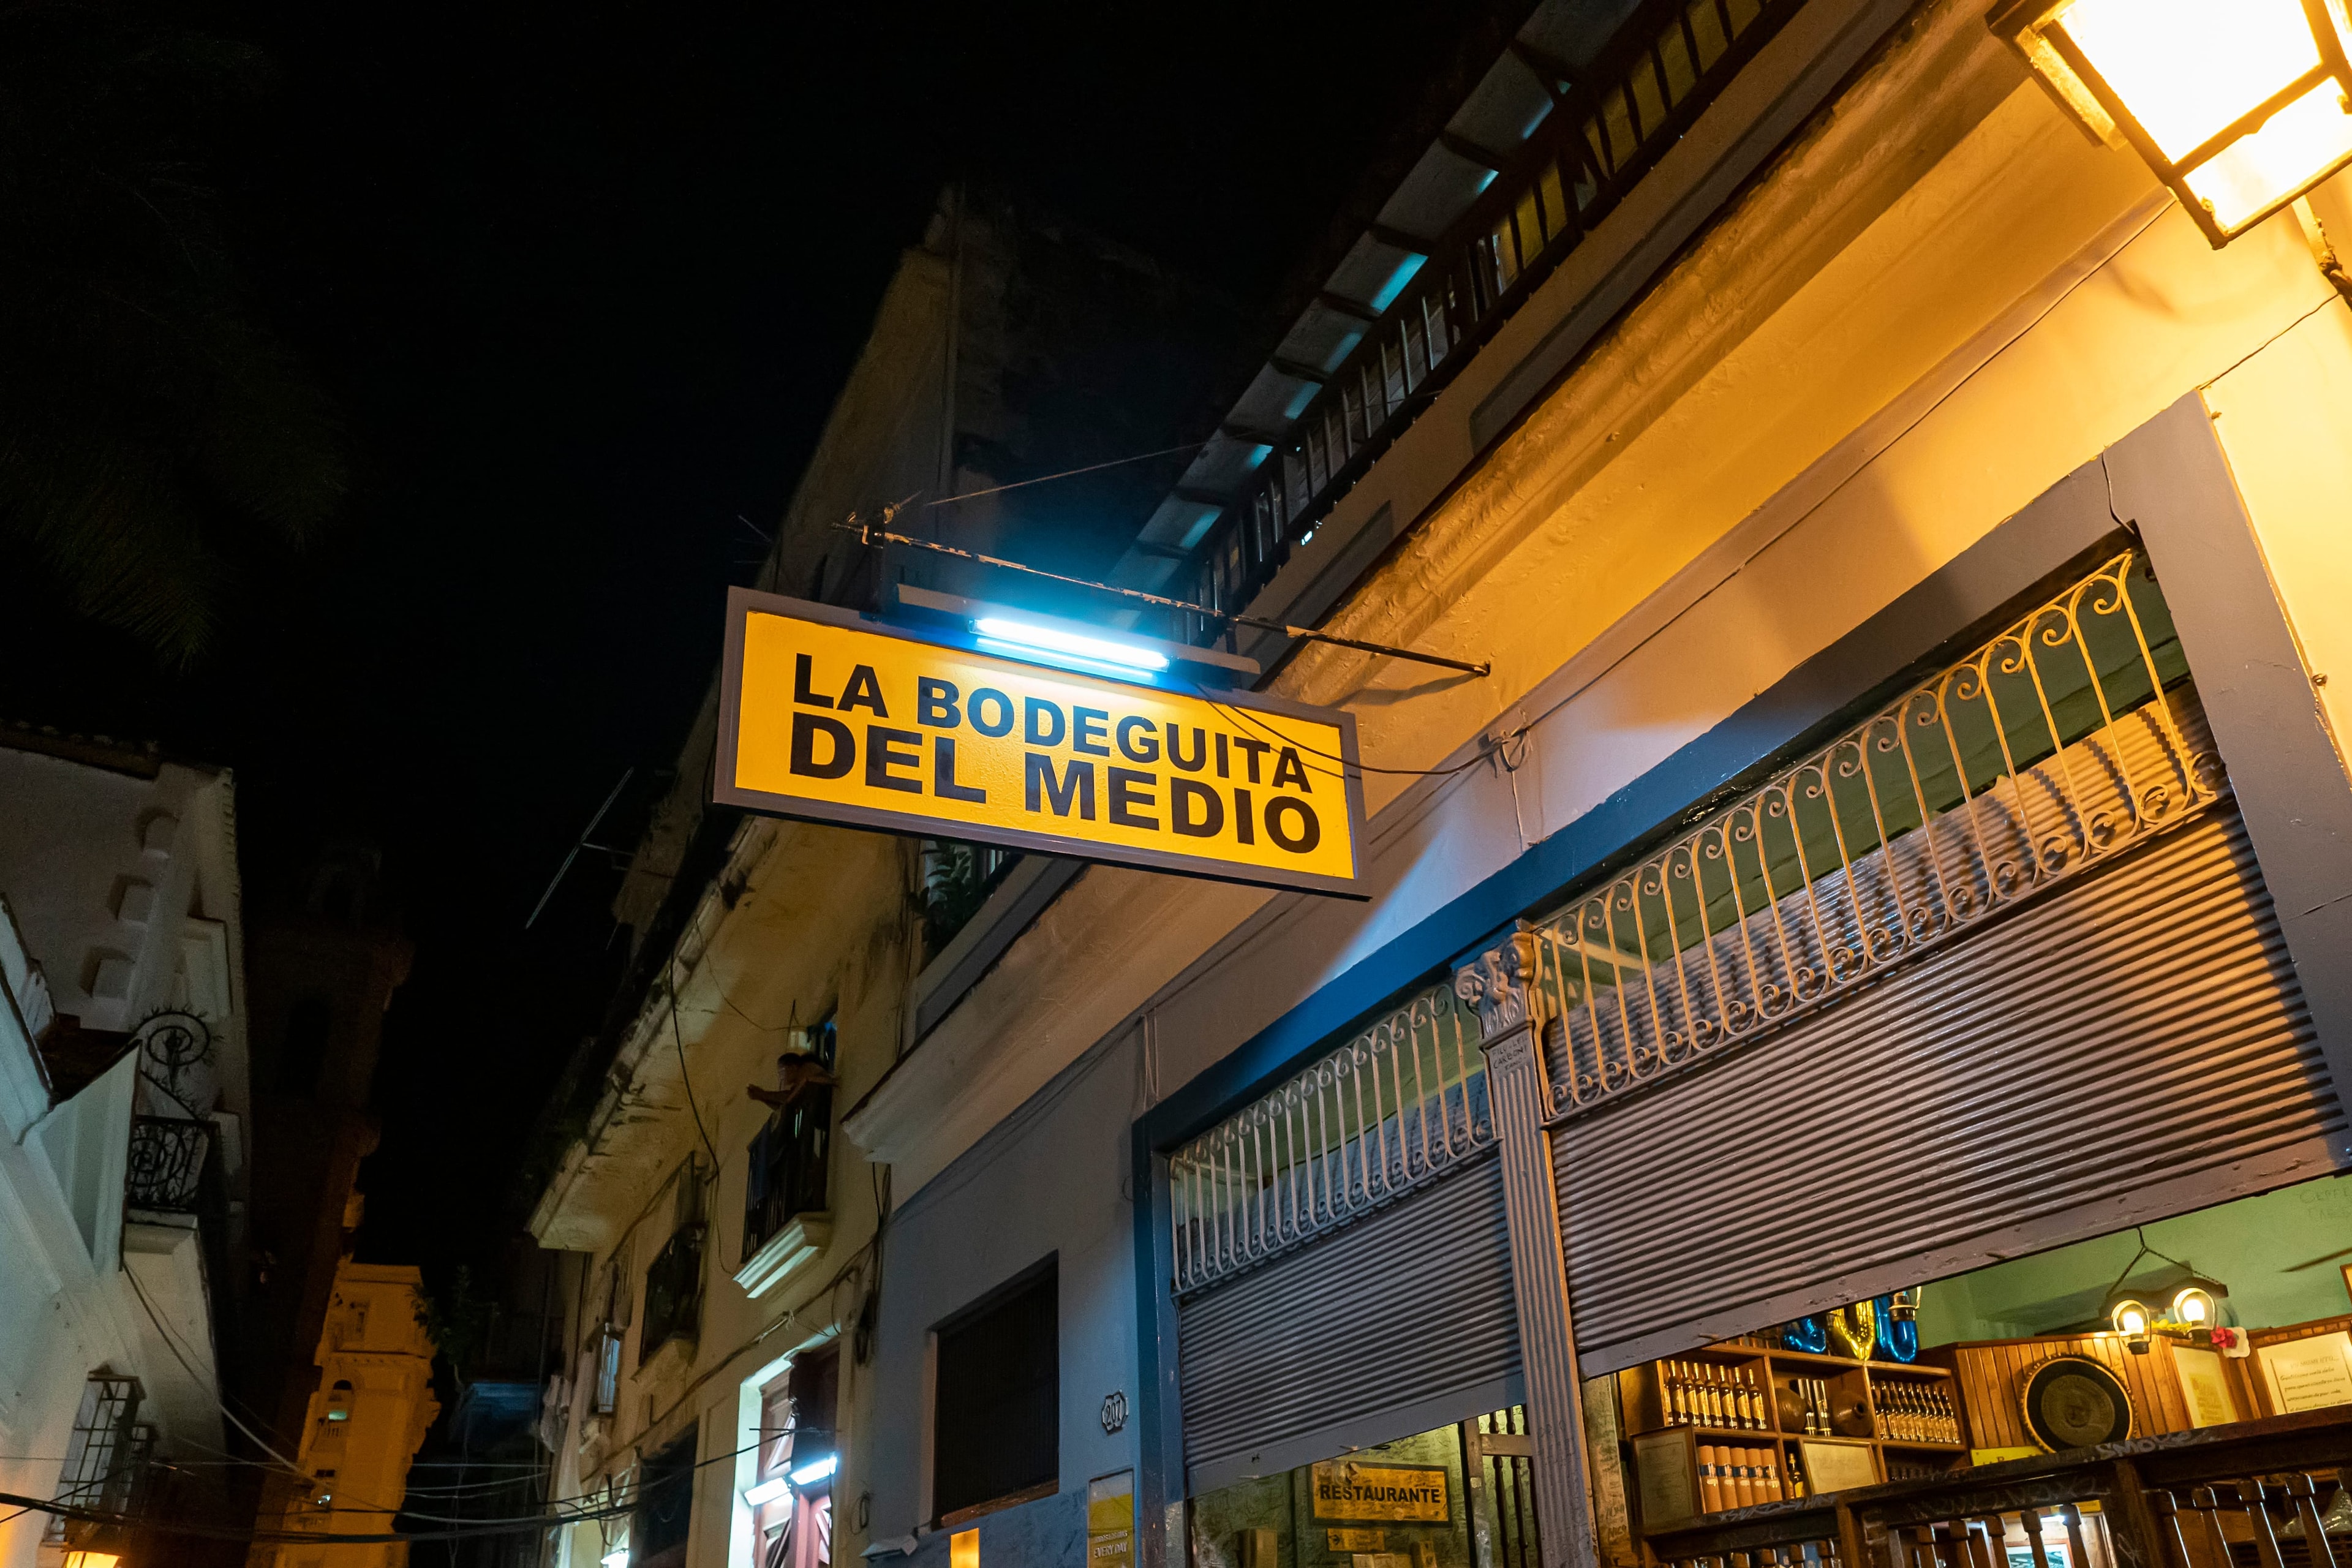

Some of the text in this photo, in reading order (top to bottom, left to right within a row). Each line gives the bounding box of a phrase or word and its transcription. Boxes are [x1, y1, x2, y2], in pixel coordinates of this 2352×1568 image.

[794, 654, 1312, 794] LA BODEGUITA
[790, 712, 1321, 854] DEL MEDIO
[1106, 1400, 1121, 1426] 207
[1320, 1483, 1441, 1504] RESTAURANTE
[1093, 1544, 1114, 1558] EVERY
